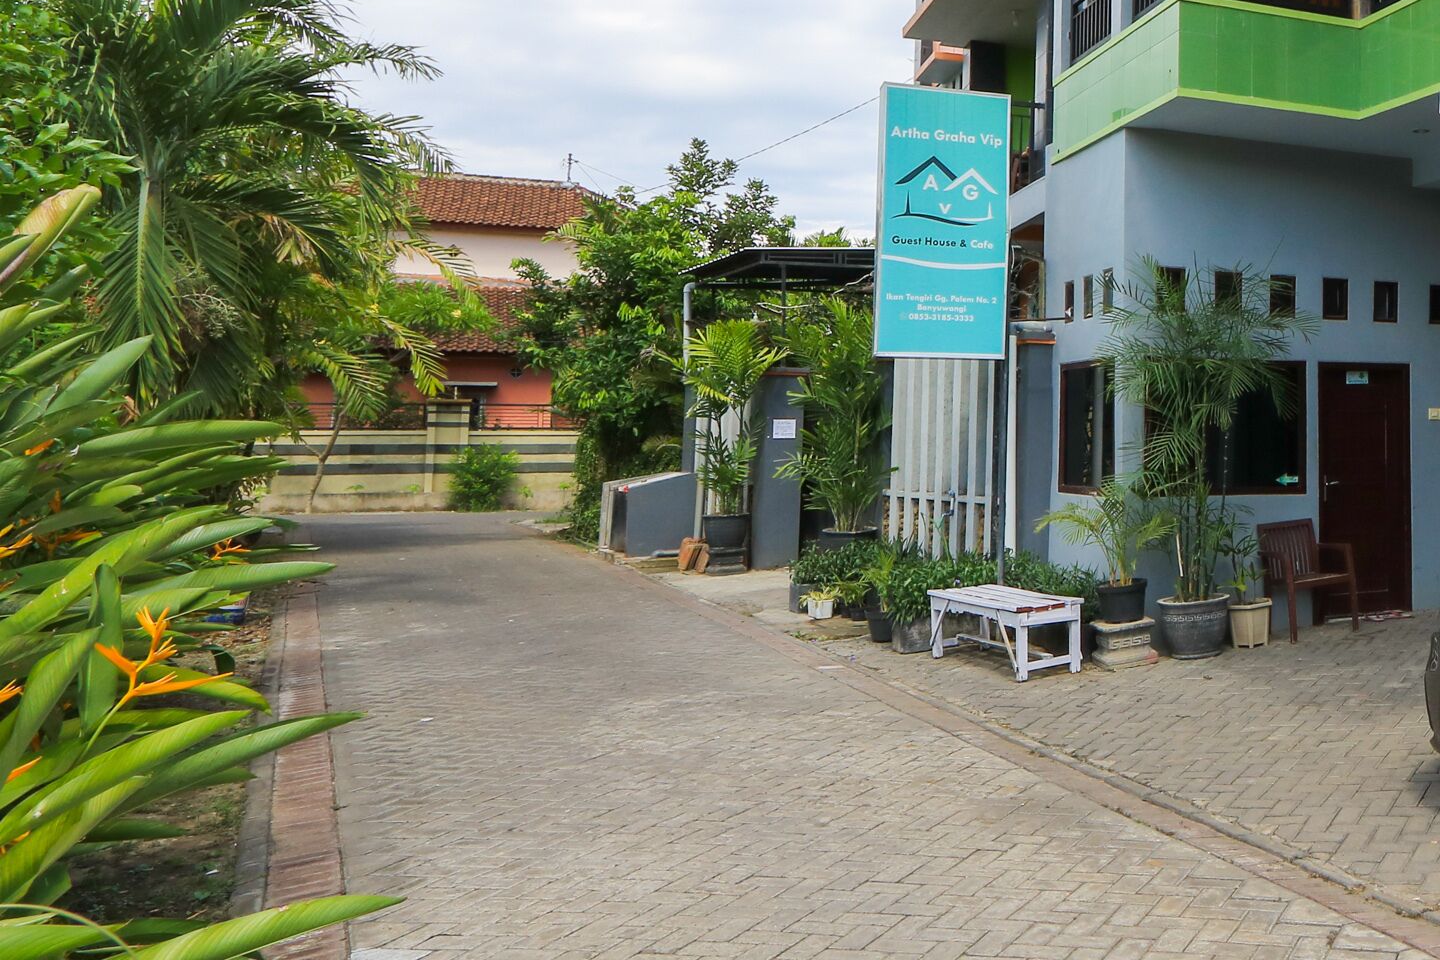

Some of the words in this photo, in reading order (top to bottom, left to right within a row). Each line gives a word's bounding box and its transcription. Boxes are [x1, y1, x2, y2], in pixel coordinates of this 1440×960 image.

[891, 126, 929, 140] Artha
[934, 129, 976, 144] Graha
[980, 133, 1003, 148] Vip
[922, 174, 938, 191] A
[962, 184, 979, 201] G
[892, 235, 922, 245] Guest
[924, 237, 957, 247] House
[959, 239, 967, 248] &
[970, 239, 994, 250] Cafe
[886, 293, 904, 301] Ikan
[950, 295, 974, 303] Palem
[976, 296, 990, 304] No.
[991, 297, 998, 305] 2
[917, 303, 967, 313] Banyuwangi
